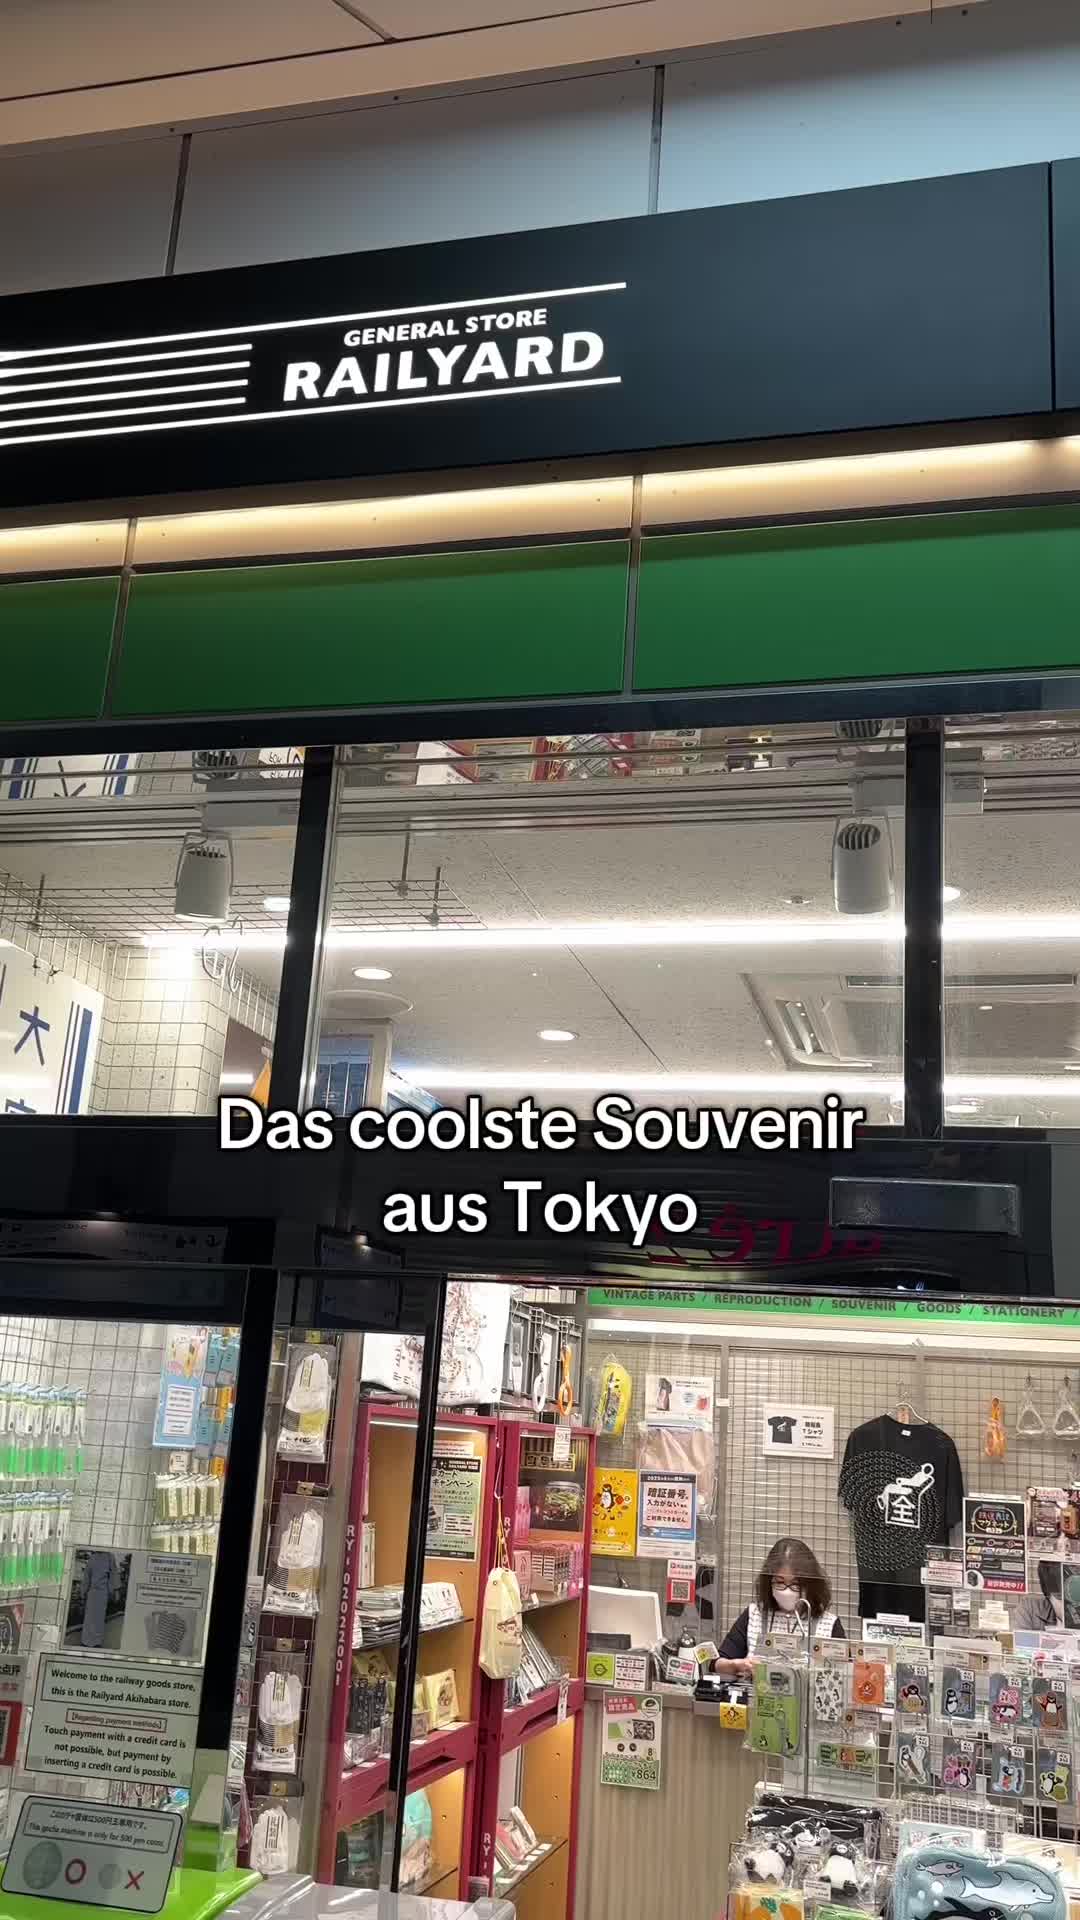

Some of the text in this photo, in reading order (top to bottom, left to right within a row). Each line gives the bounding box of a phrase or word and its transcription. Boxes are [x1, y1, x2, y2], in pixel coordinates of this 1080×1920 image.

[343, 308, 547, 347] GENERAL STORE
[283, 331, 604, 402] RAILYARD
[603, 1288, 655, 1300] VINTAGE
[658, 1291, 695, 1302] PARTS
[714, 1294, 812, 1308] REPRODUCTION
[831, 1299, 896, 1312] SOUVENIR
[917, 1302, 961, 1314] GOODS
[983, 1304, 1064, 1319] STATIONERY
[433, 1479, 473, 1488] キャンペーン
[51, 1669, 87, 1680] Welcome
[100, 1674, 112, 1682] the
[115, 1675, 144, 1687] railway
[146, 1679, 171, 1688] goods
[51, 1687, 191, 1709] this is the Railyard Akihabara store.
[44, 1725, 68, 1736] Touch
[70, 1729, 105, 1741] payment
[107, 1731, 125, 1741] with
[134, 1734, 158, 1745] credit
[160, 1737, 178, 1747] card
[180, 1739, 186, 1748] is
[54, 1743, 172, 1765] not possible, but payment by
[44, 1756, 79, 1769] inserting
[88, 1761, 111, 1771] credit
[114, 1764, 131, 1774] card
[133, 1766, 140, 1775] is
[142, 1767, 177, 1779] possible.
[93, 1830, 108, 1841] only
[109, 1832, 119, 1840] for
[120, 1834, 133, 1843] 500
